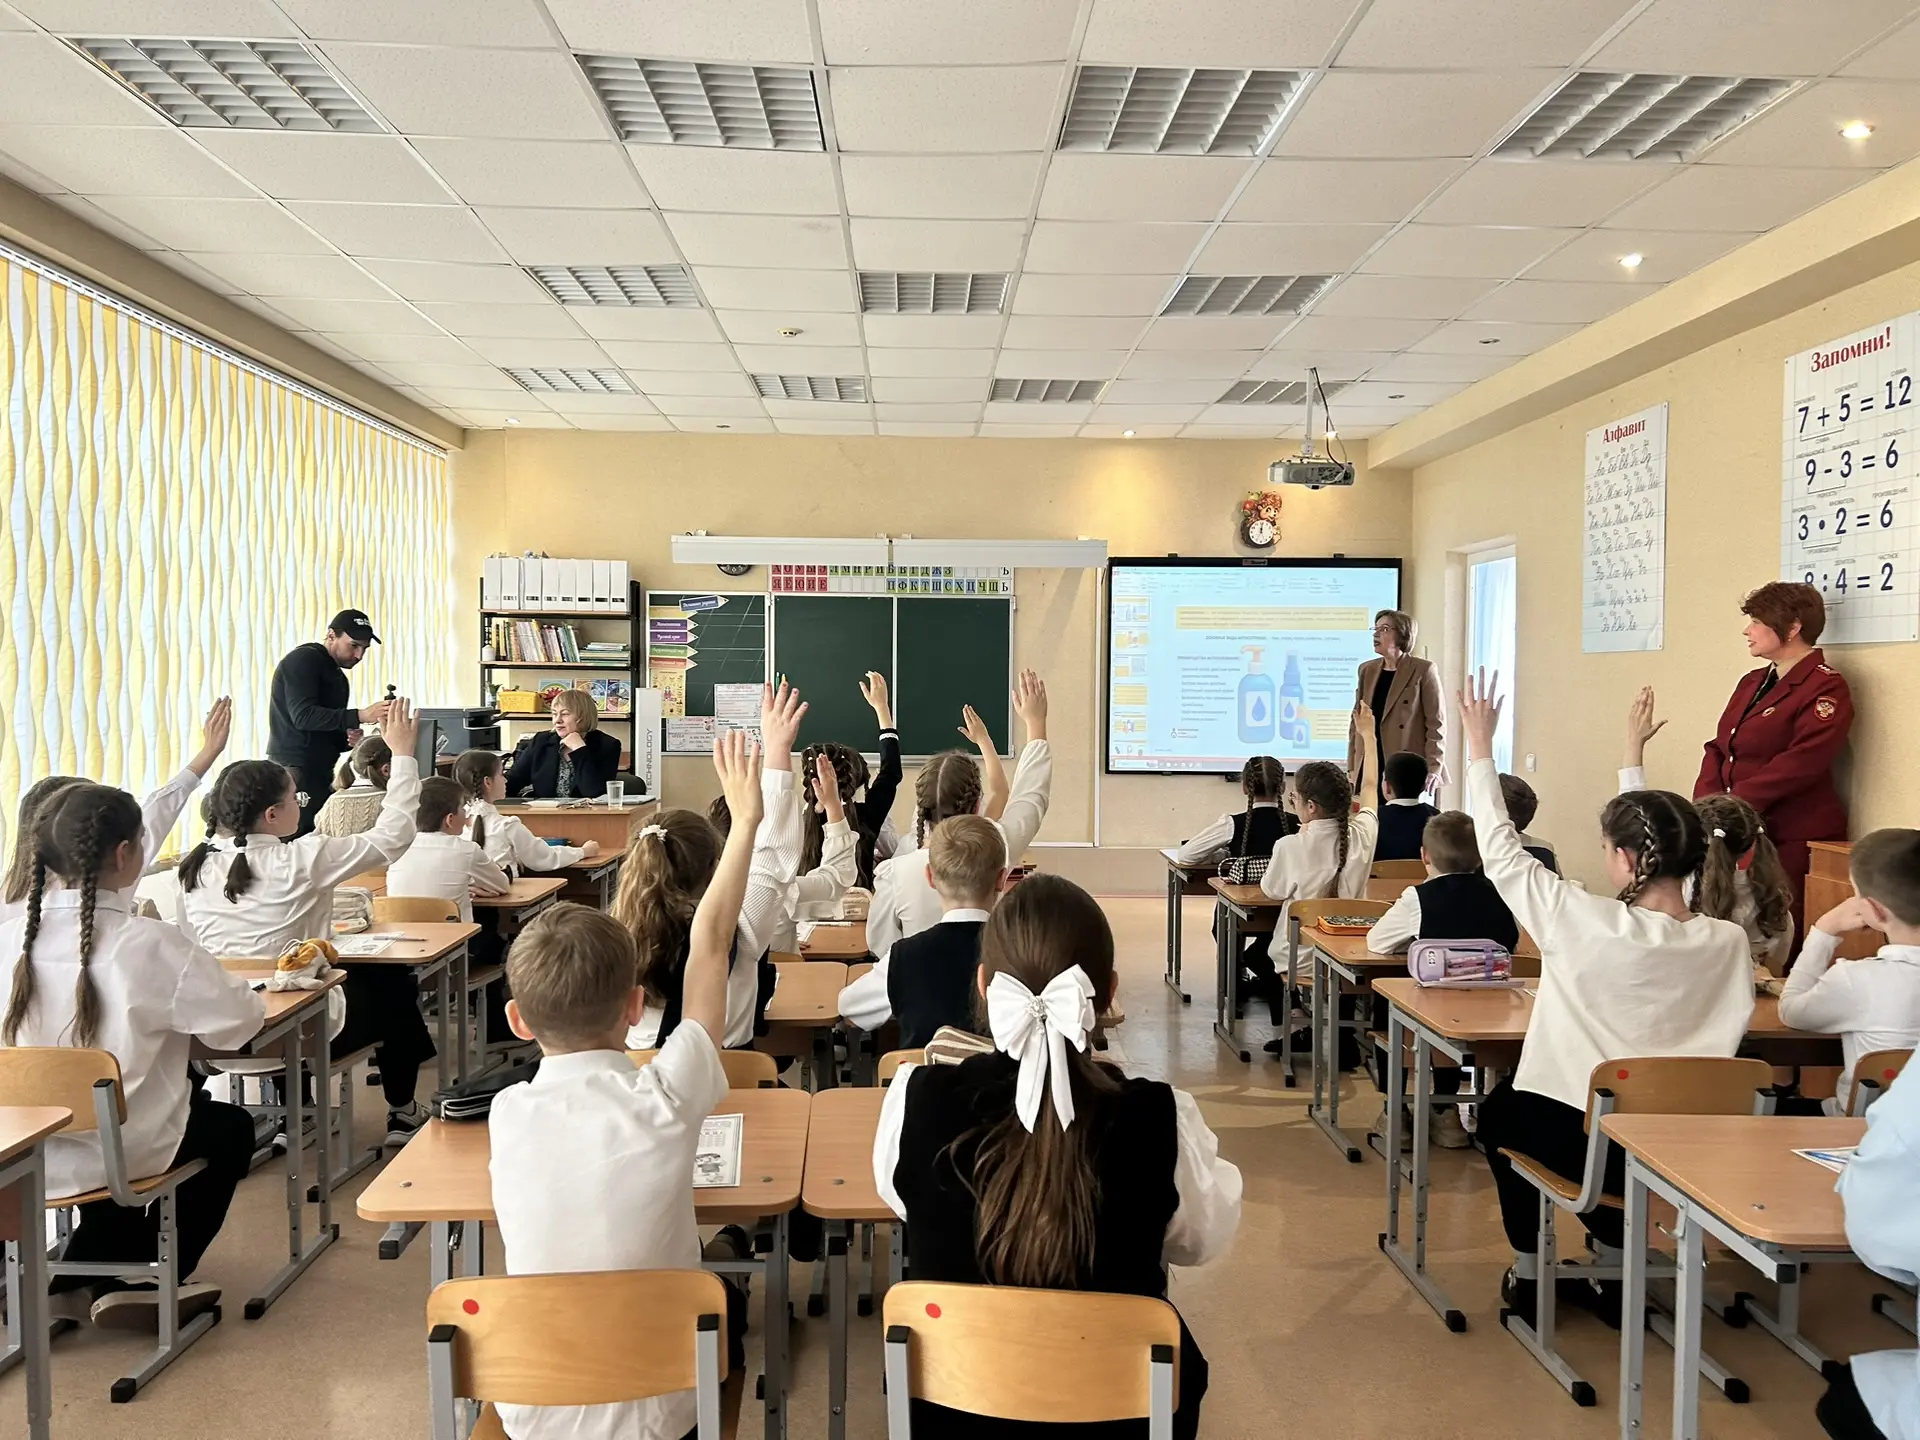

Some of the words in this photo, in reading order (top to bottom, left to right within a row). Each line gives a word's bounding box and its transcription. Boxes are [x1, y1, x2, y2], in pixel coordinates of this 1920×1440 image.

[1811, 326, 1890, 372] Запомни!
[1798, 406, 1809, 433] 7
[1817, 407, 1830, 427] +
[1839, 393, 1851, 421] 5
[1860, 397, 1874, 411] =
[1885, 376, 1911, 409] 12
[1603, 419, 1646, 443] Алфавит
[1805, 459, 1816, 485] 9
[1840, 450, 1852, 478] 3
[1862, 455, 1875, 469] =
[1885, 439, 1898, 468] 6
[1798, 514, 1808, 540] 3
[1835, 507, 1847, 535] 2
[1856, 514, 1870, 527] =
[1880, 499, 1893, 528] 6
[773, 579, 781, 588] Я
[795, 579, 804, 588] Ю
[820, 580, 827, 588] Е
[888, 581, 896, 590] П
[898, 581, 907, 590] Ф
[911, 581, 918, 590] К
[922, 581, 929, 590] Т
[945, 581, 952, 591] С
[956, 582, 963, 591] Х
[967, 582, 975, 593] Ц
[978, 582, 986, 591] Ч
[1002, 582, 1008, 591] Ь
[921, 566, 930, 576] Д
[932, 566, 942, 574] Ж
[1835, 568, 1847, 594] 4
[1857, 576, 1870, 588] =
[1880, 562, 1893, 591] 2
